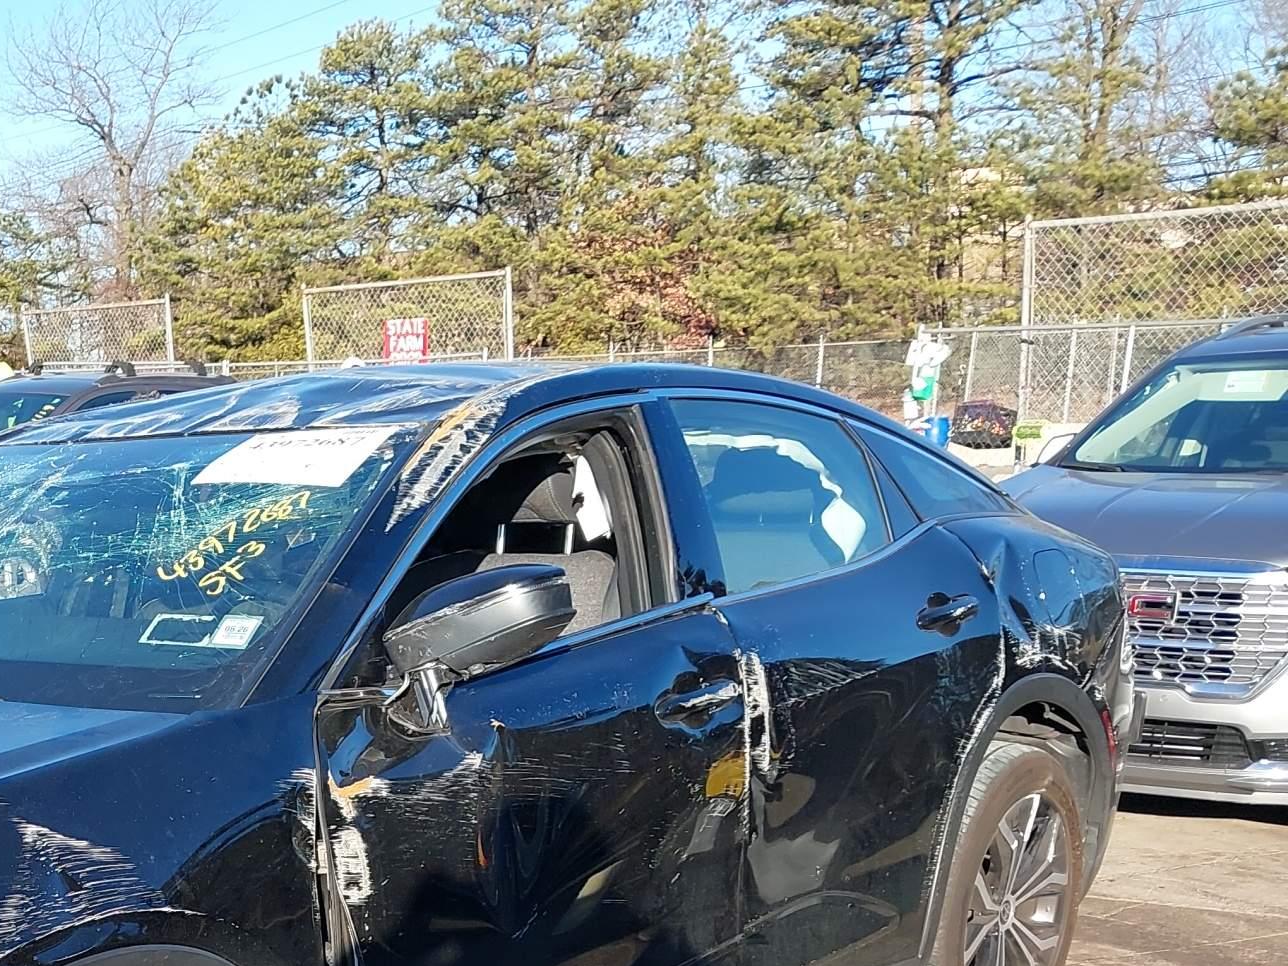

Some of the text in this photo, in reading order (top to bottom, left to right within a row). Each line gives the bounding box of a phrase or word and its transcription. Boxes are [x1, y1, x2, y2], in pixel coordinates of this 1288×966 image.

[386, 318, 425, 336] STATE
[390, 334, 423, 352] FARM
[156, 490, 311, 580] 43972687
[198, 540, 266, 595] SF3
